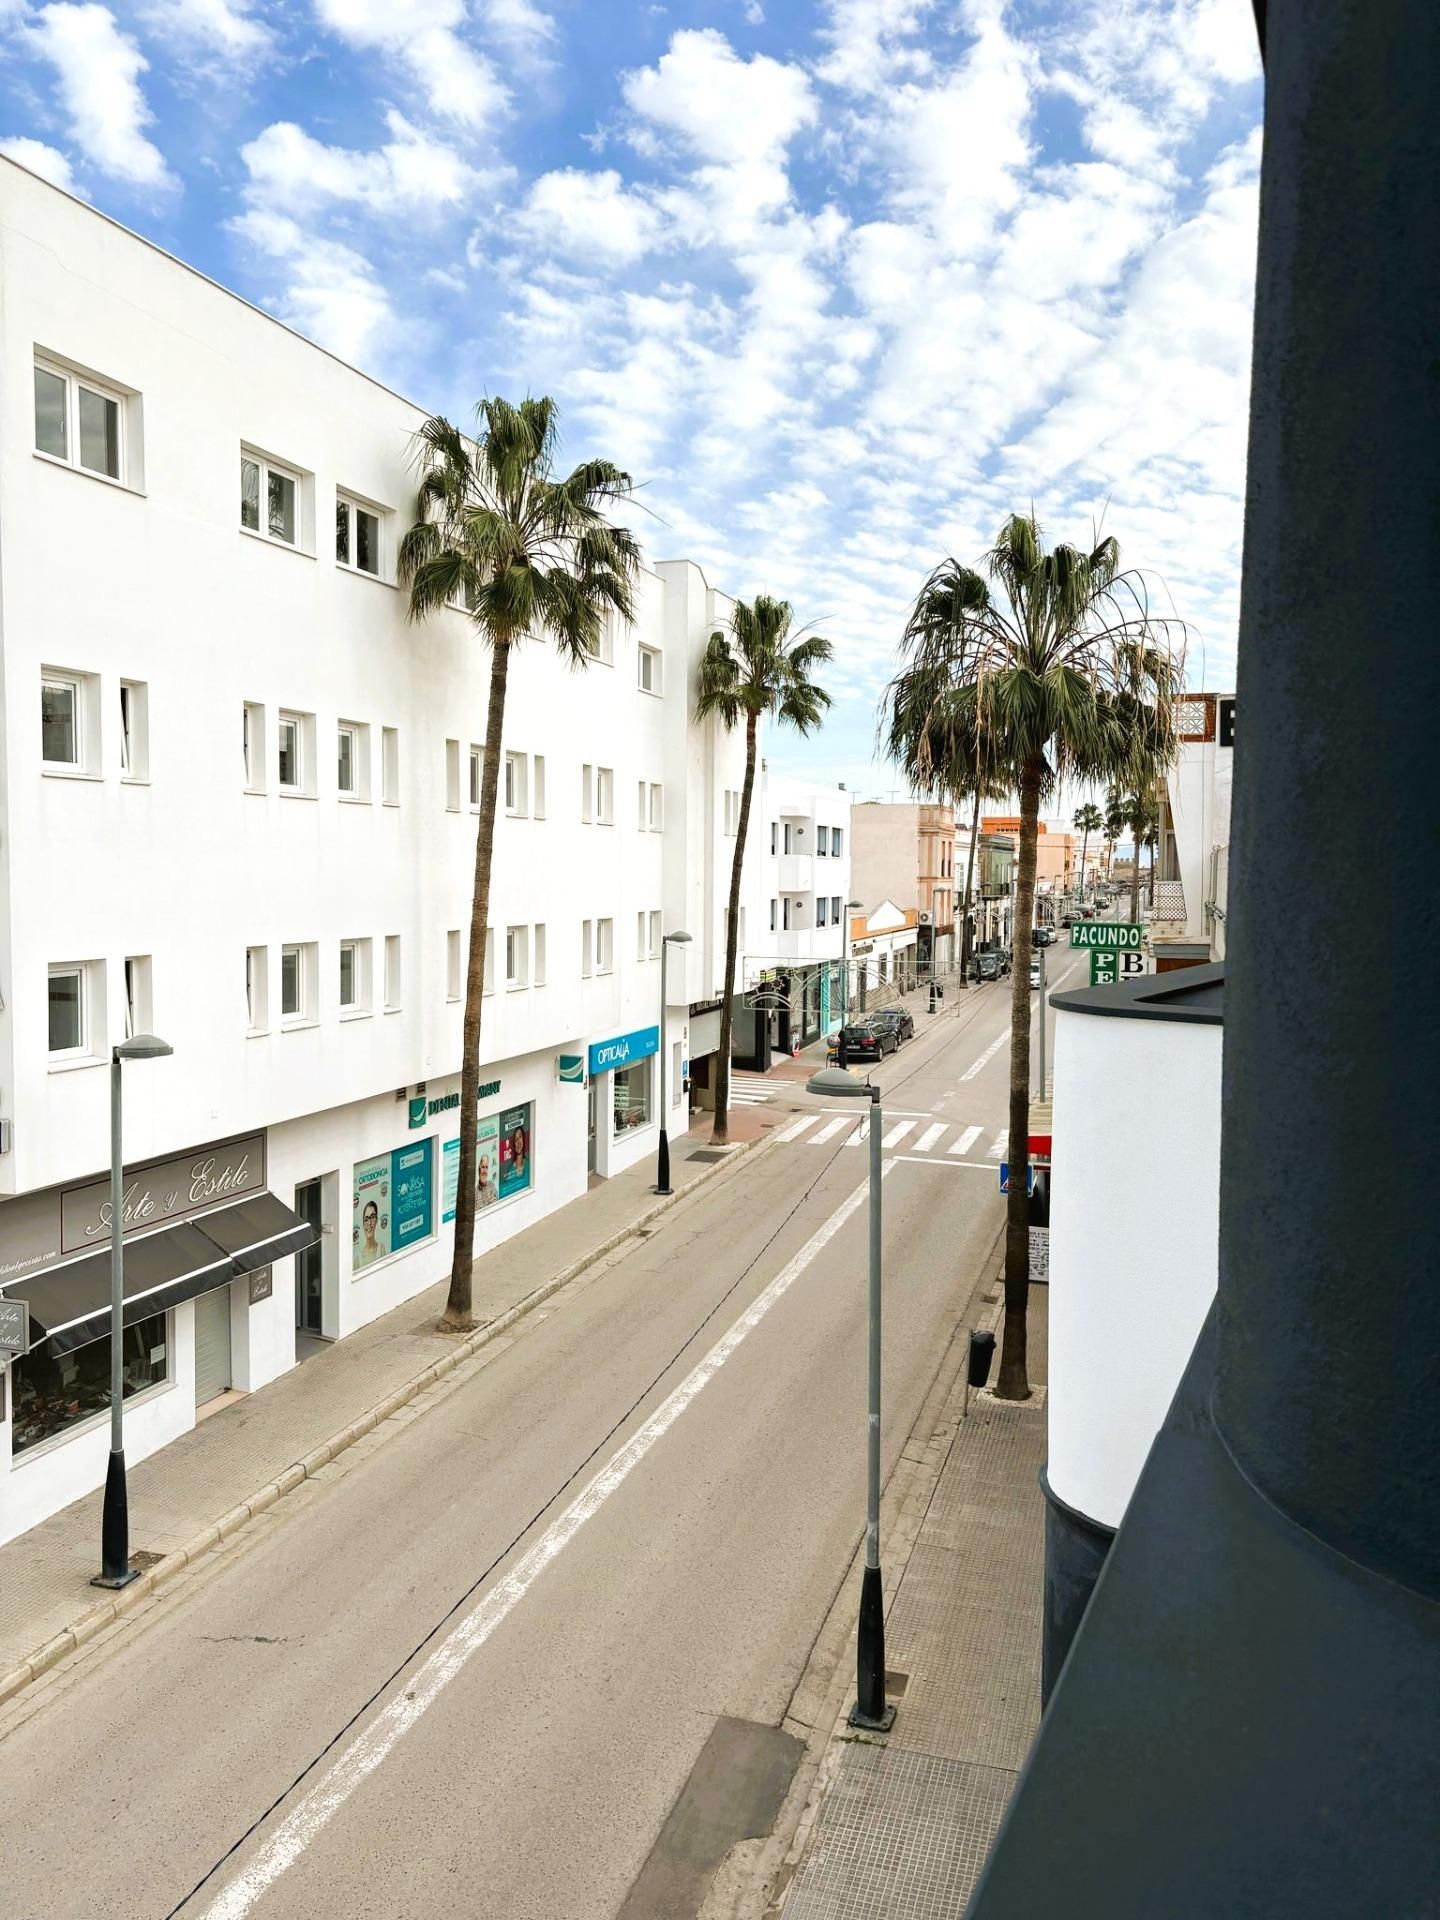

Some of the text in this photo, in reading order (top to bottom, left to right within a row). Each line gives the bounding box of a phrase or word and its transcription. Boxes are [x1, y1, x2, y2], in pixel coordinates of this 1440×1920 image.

[1072, 926, 1139, 947] FACUNDO
[1121, 952, 1144, 980] B
[85, 1182, 155, 1235] Arte
[188, 1154, 248, 1202] Estilo
